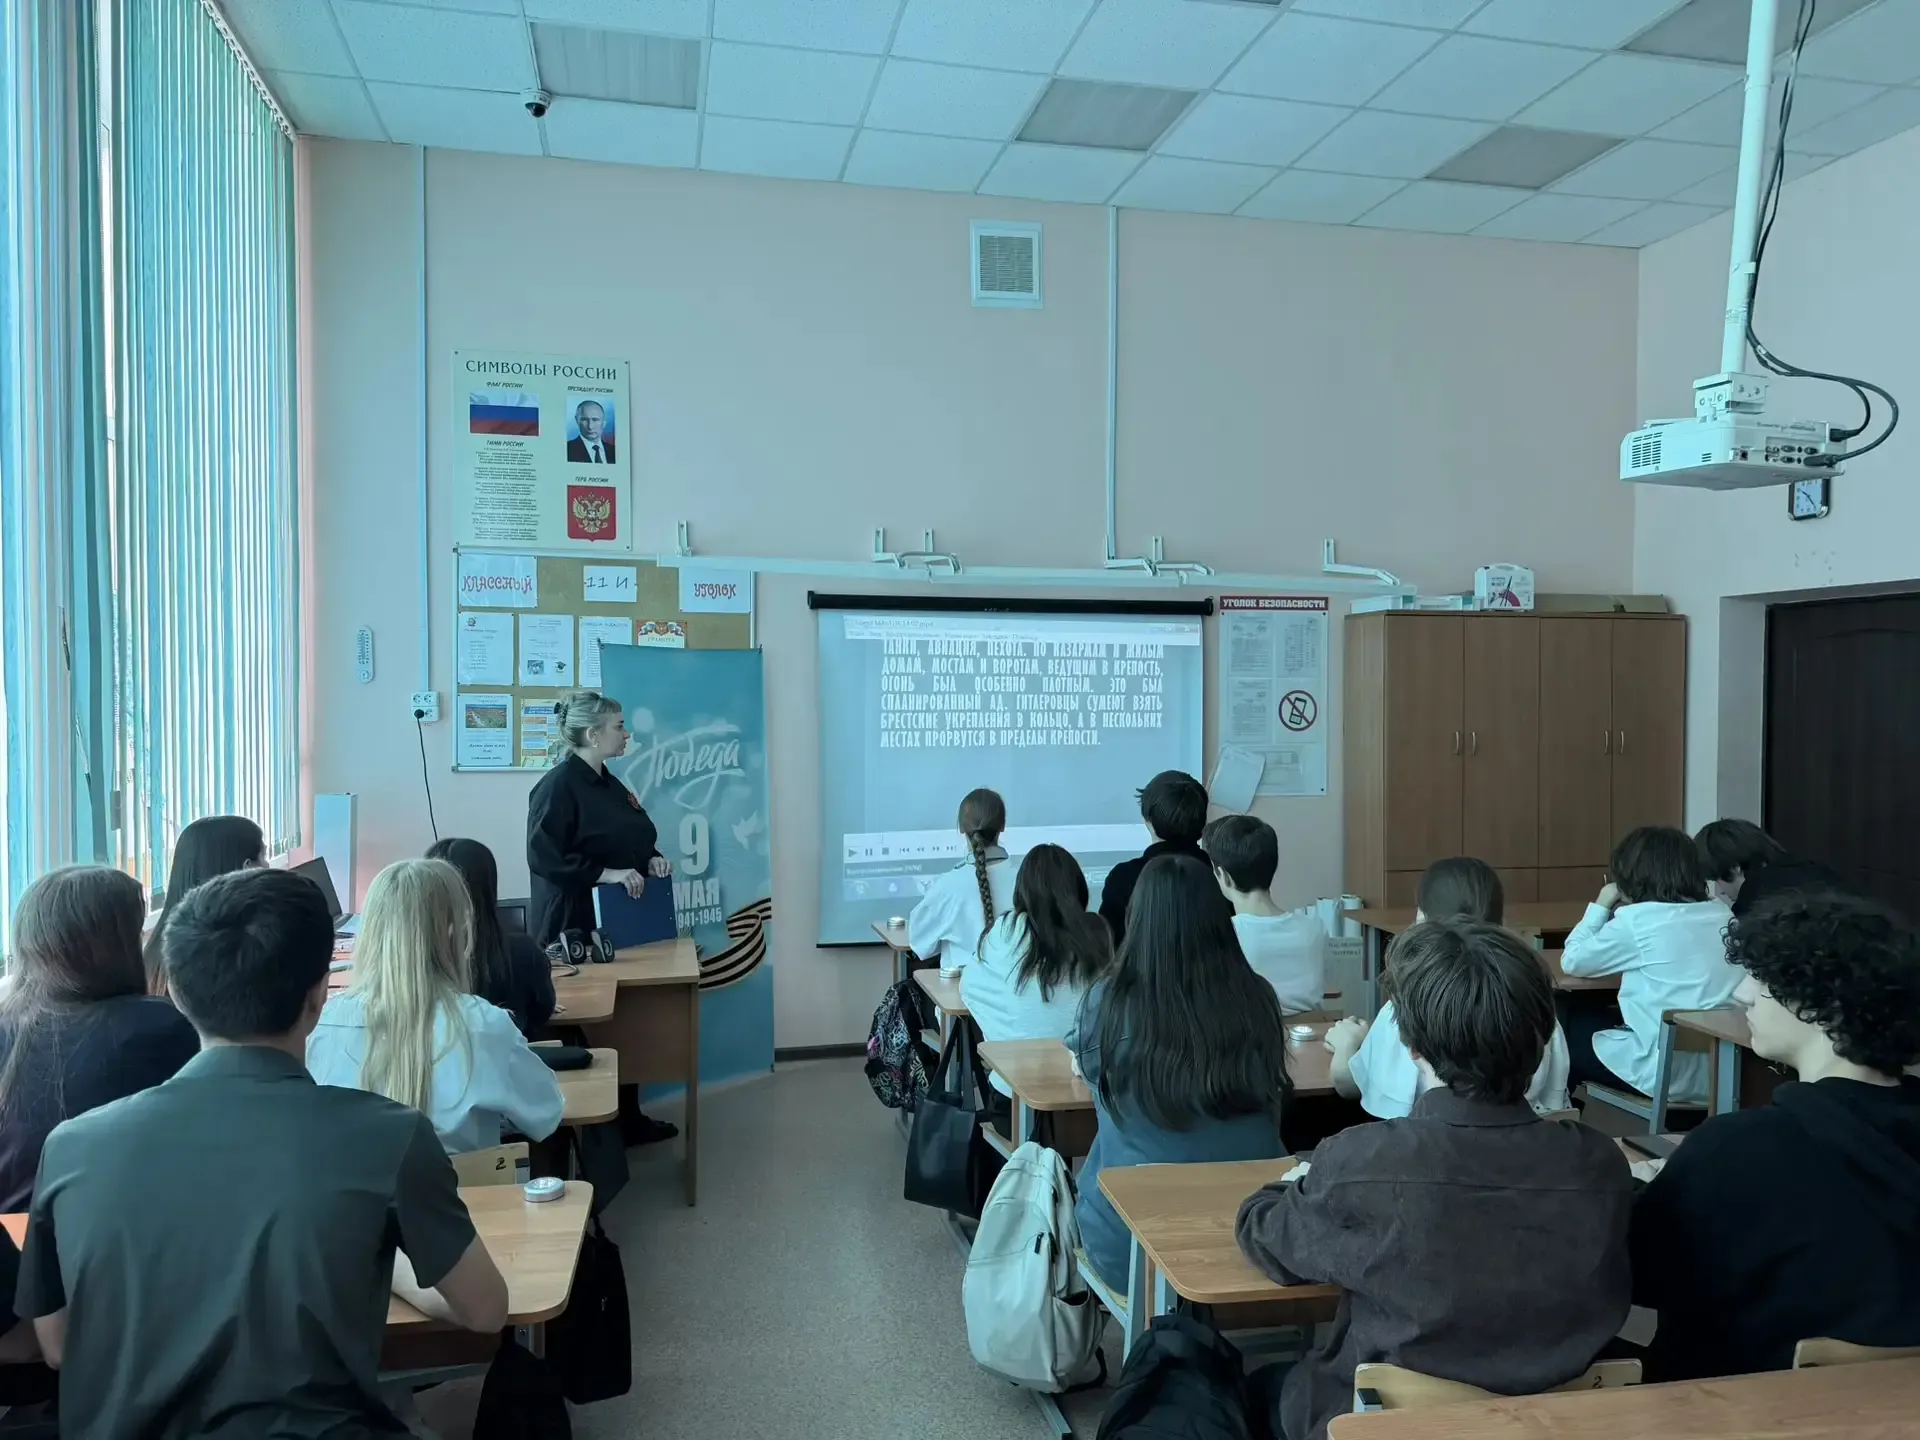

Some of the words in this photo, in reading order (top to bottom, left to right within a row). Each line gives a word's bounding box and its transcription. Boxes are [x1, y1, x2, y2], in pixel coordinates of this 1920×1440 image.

[466, 360, 546, 376] СИМВОЛЫ
[553, 365, 617, 380] РОССИИ
[462, 575, 532, 594] КЛАССНЫЙ
[586, 577, 608, 588] 11
[616, 576, 628, 589] И
[694, 583, 736, 599] УГОЛОК
[1223, 599, 1257, 608] УГОЛОК
[1258, 599, 1326, 608] БЕЗОПАСНОСТИ
[928, 640, 980, 658] АВИАЦИЯ,
[987, 641, 1027, 657] ПЕХОТА.
[1034, 642, 1046, 657] ПО
[1126, 644, 1164, 659] ЖИЛЫМ
[881, 657, 926, 675] ДОМАМ,
[932, 657, 974, 674] МОСТАМ
[980, 658, 987, 674] И
[993, 658, 1042, 676] ВОРОТАМ,
[1048, 659, 1097, 676] ВЕДУЩИМ
[1102, 660, 1109, 675] В
[1114, 660, 1164, 677] КРЕПОСТЬ,
[881, 675, 915, 692] ОГОНЬ
[933, 676, 956, 692] БЫЛ
[974, 676, 1026, 692] ОСОБЕННО
[1042, 677, 1094, 693] ПЛОТНЫМ.
[1110, 677, 1126, 692] ЭТО
[1142, 678, 1163, 692] БЫЛ
[881, 693, 981, 710] СПЛАНИРОВАННЫЙ
[990, 695, 1008, 711] АД.
[1016, 695, 1079, 711] ГИТЛЕРОВЦЫ
[1087, 695, 1126, 711] СУМЕЮТ
[1133, 695, 1163, 710] ВЗЯТЬ
[880, 713, 938, 729] БРЕСТСКИЕ
[945, 712, 1010, 730] УКРЕПЛЕНИЯ
[1017, 713, 1024, 727] В
[1030, 713, 1071, 729] КОЛЬЦО,
[1077, 713, 1084, 728] А
[1090, 713, 1096, 728] В
[1102, 713, 1162, 728] НЕСКОЛЬКИХ
[880, 731, 921, 747] МЕСТАХ
[925, 731, 985, 748] ПРОРВУТСЯ
[989, 731, 996, 746] В
[1000, 730, 1047, 747] ПРЕДЕЛЫ
[1050, 730, 1101, 745] КРЕПОСТИ.
[626, 724, 745, 808] Победа
[679, 813, 710, 875] 9
[673, 877, 720, 911] МАЯ
[676, 907, 722, 929] 941-1945
[495, 1157, 507, 1171] 2
[1592, 1375, 1603, 1389] 2
